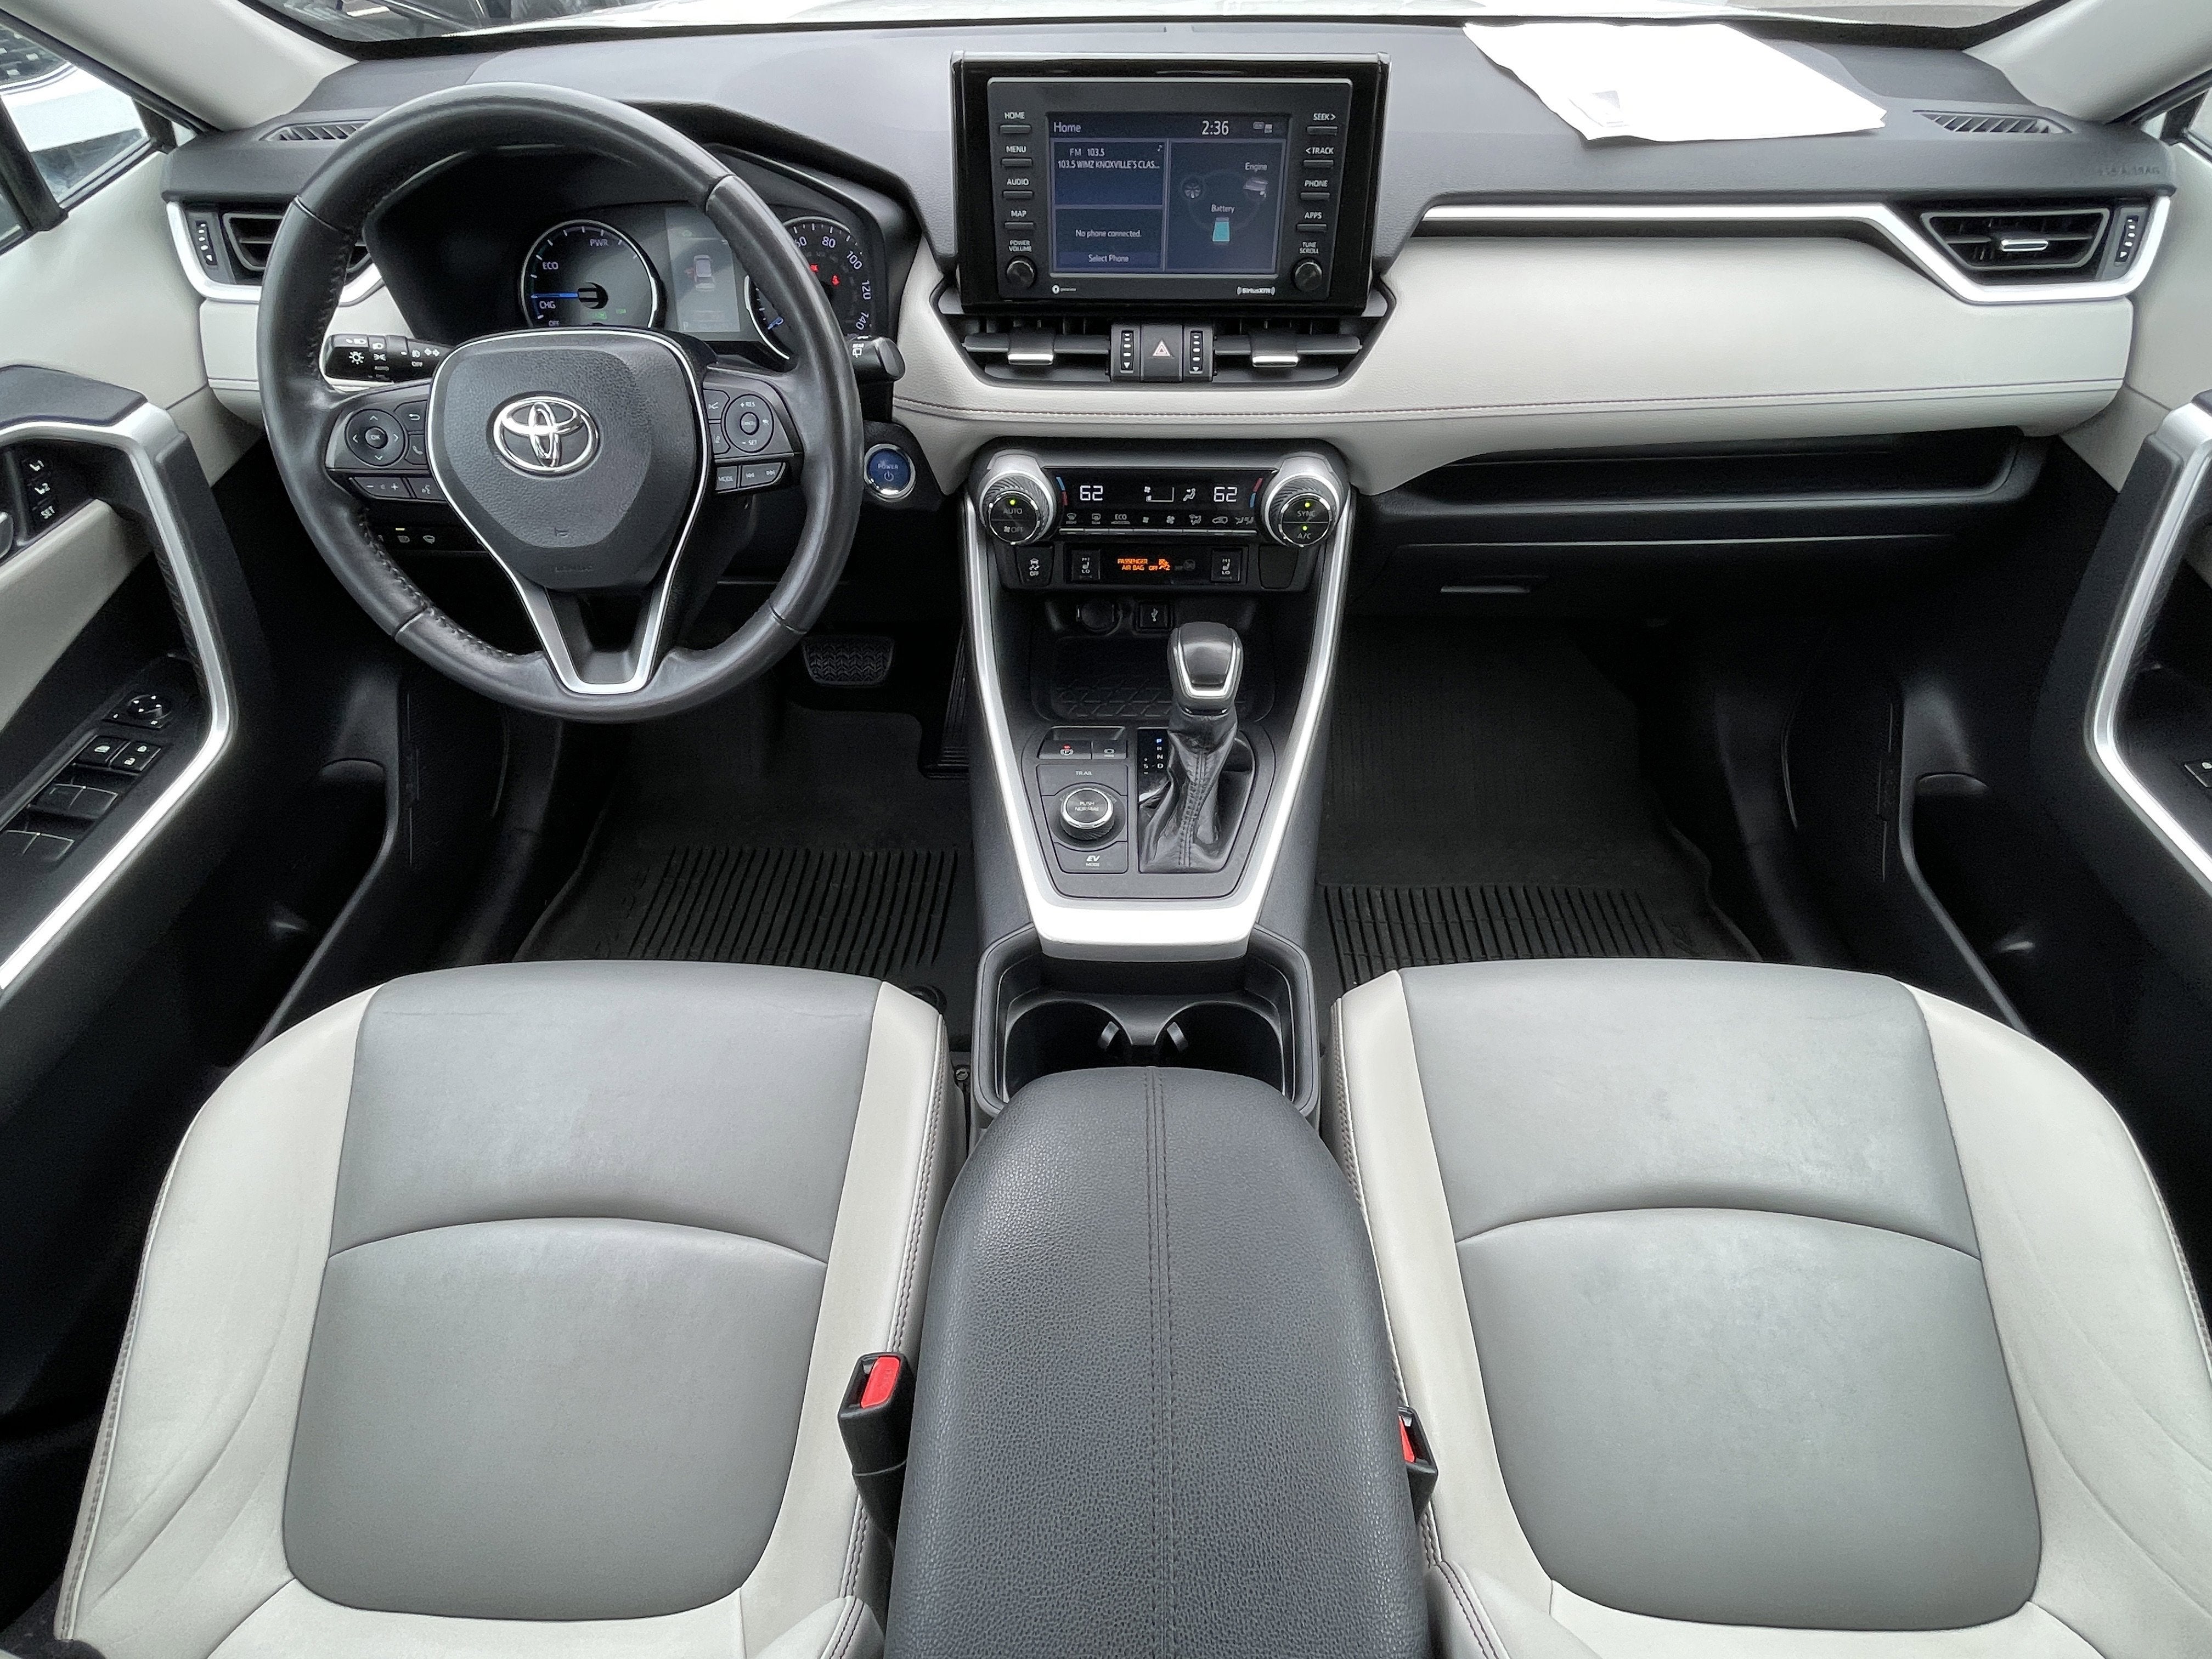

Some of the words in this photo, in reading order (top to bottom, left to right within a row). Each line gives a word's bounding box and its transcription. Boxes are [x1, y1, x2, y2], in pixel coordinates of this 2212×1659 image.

[1053, 122, 1081, 133] Home
[1201, 120, 1229, 135] 2:36
[1069, 148, 1081, 156] FM
[1087, 148, 1105, 157] 103.5
[1058, 160, 1076, 169] 103.5
[1245, 162, 1267, 172] Engine
[1211, 204, 1235, 213] Battery
[1086, 230, 1107, 238] phone
[822, 236, 836, 248] 80
[846, 250, 863, 270] 100
[1088, 254, 1107, 262] Select
[1108, 254, 1129, 262] Phone
[542, 261, 558, 270] ECO
[861, 280, 871, 300] 120
[855, 312, 869, 330] 140
[1080, 485, 1103, 501] 62
[1214, 486, 1238, 503] 62
